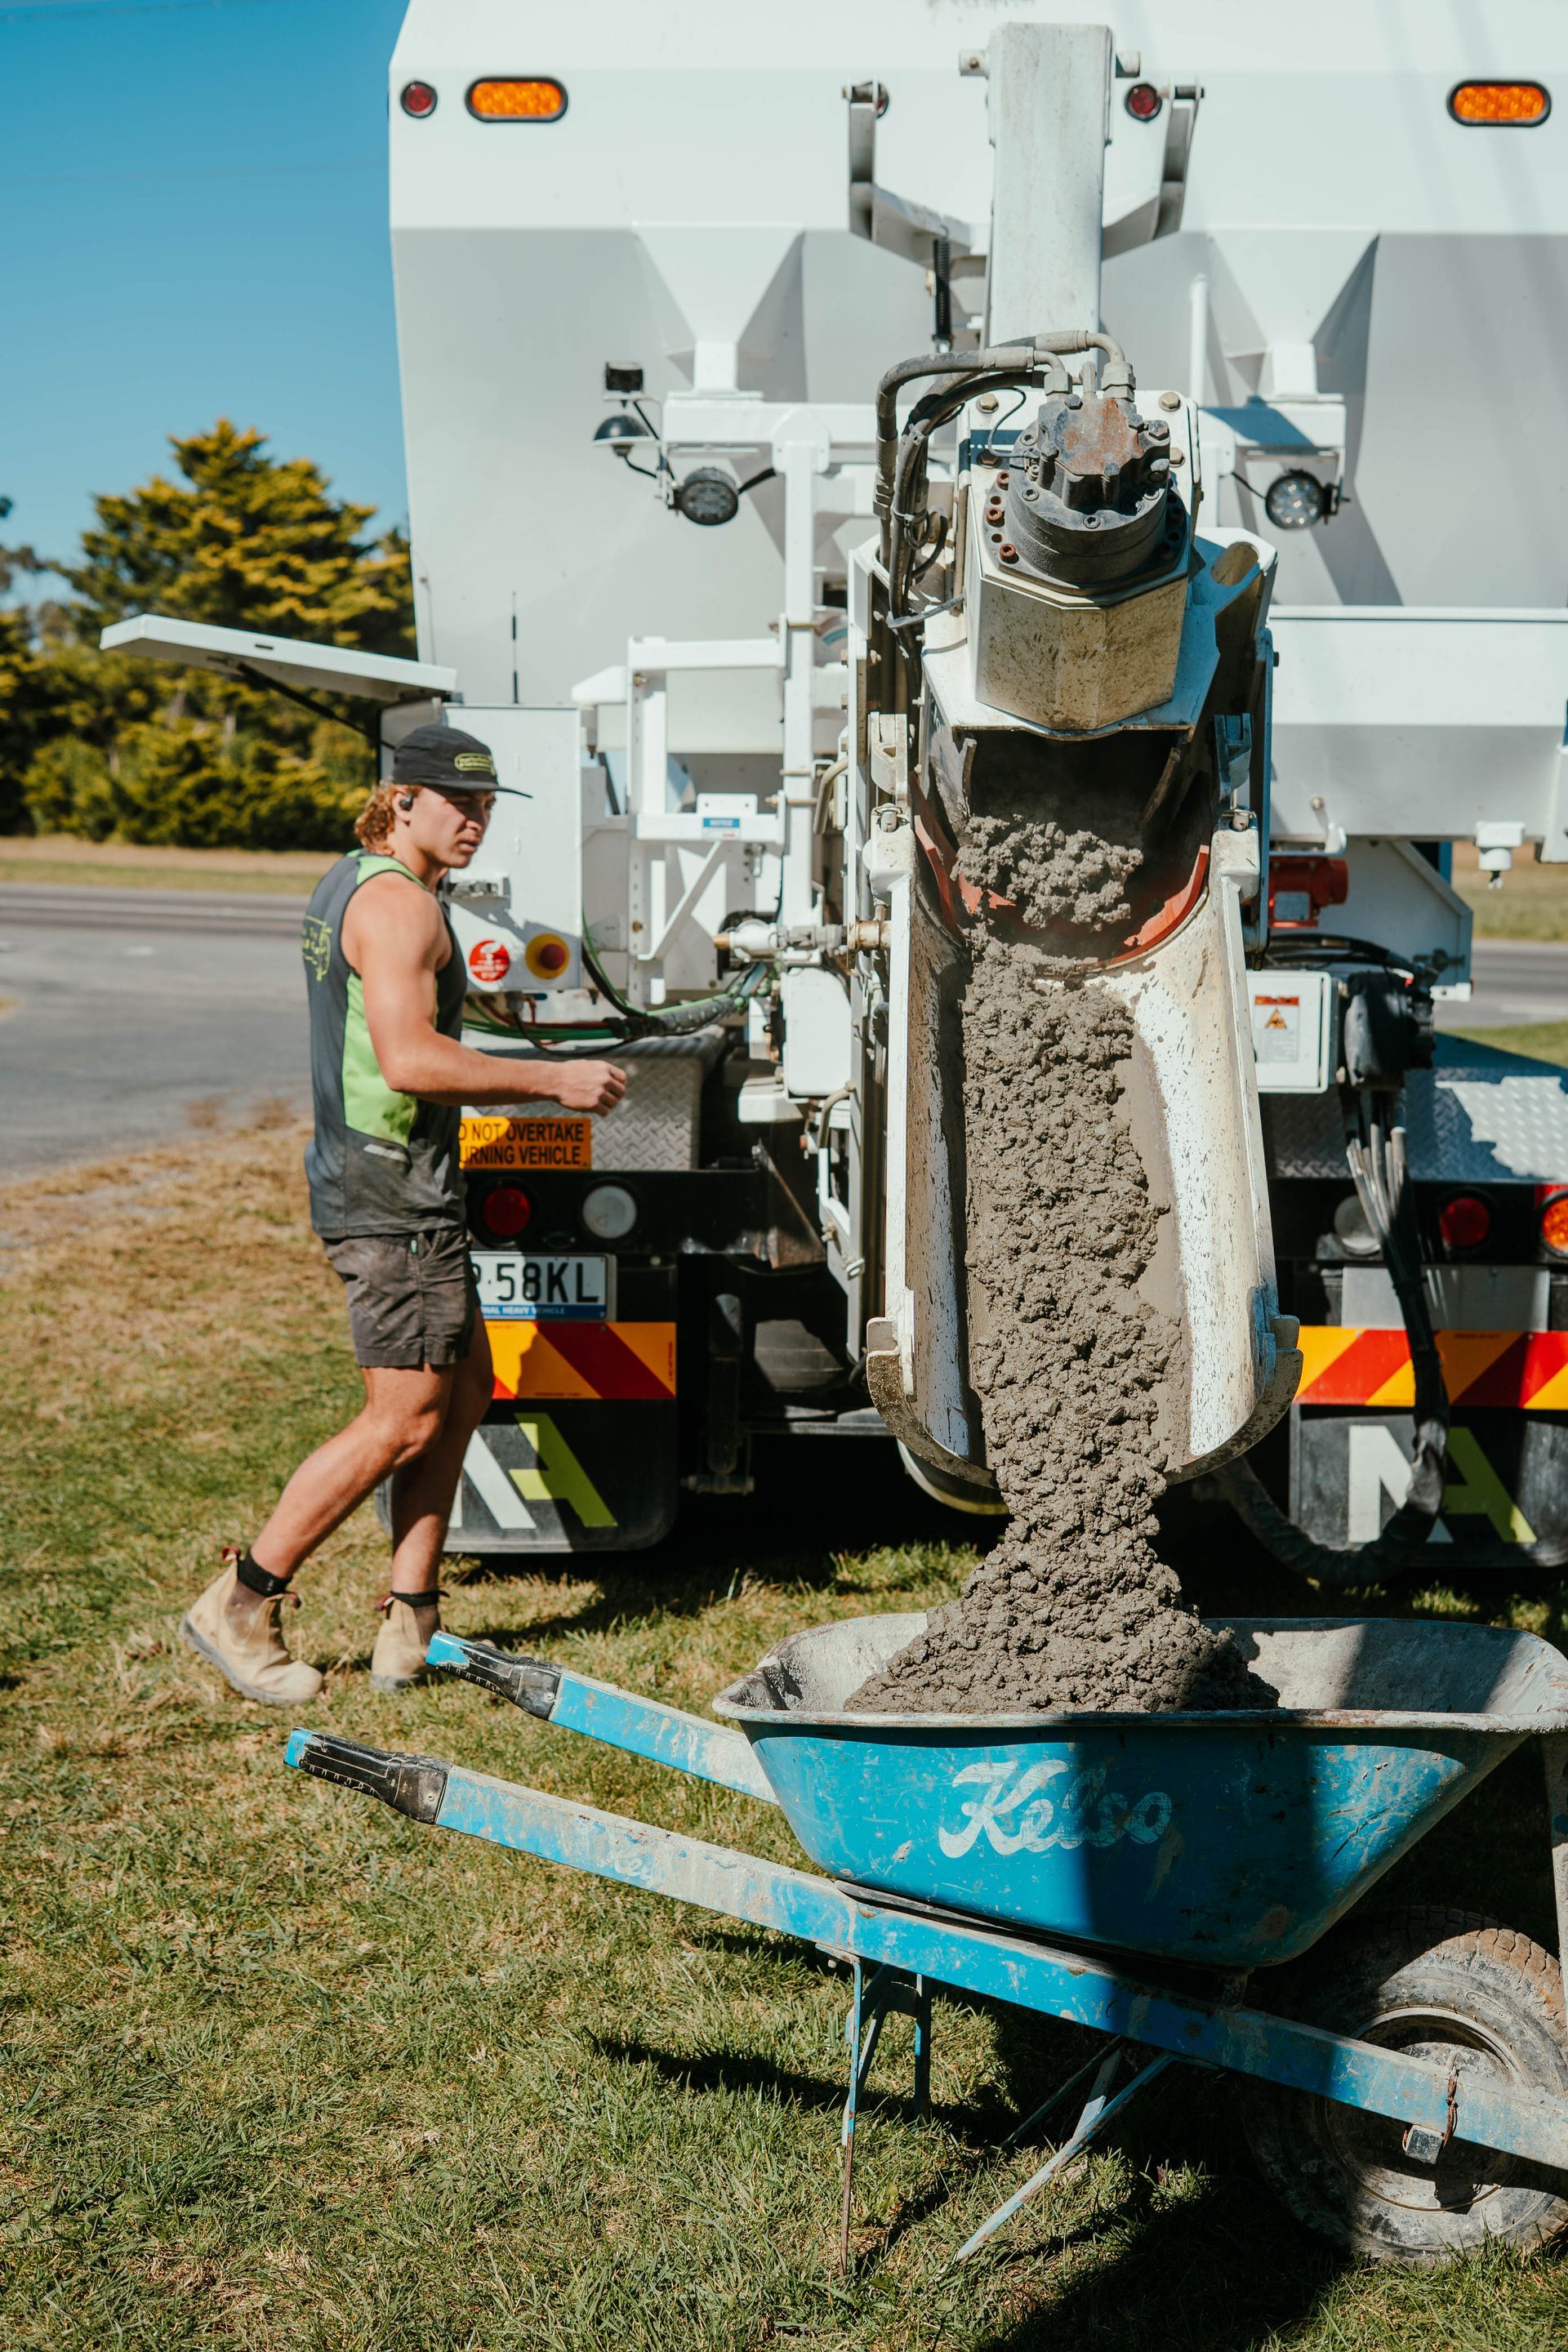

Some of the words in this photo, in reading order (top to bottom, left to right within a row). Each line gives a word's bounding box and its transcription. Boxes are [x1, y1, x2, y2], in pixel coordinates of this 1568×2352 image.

[472, 1123, 501, 1142] NOT
[506, 1123, 585, 1142] OVERTAKE
[459, 1145, 515, 1165] URNING
[519, 1145, 581, 1165] VEHICLE
[938, 1758, 1172, 1859] Kelso
